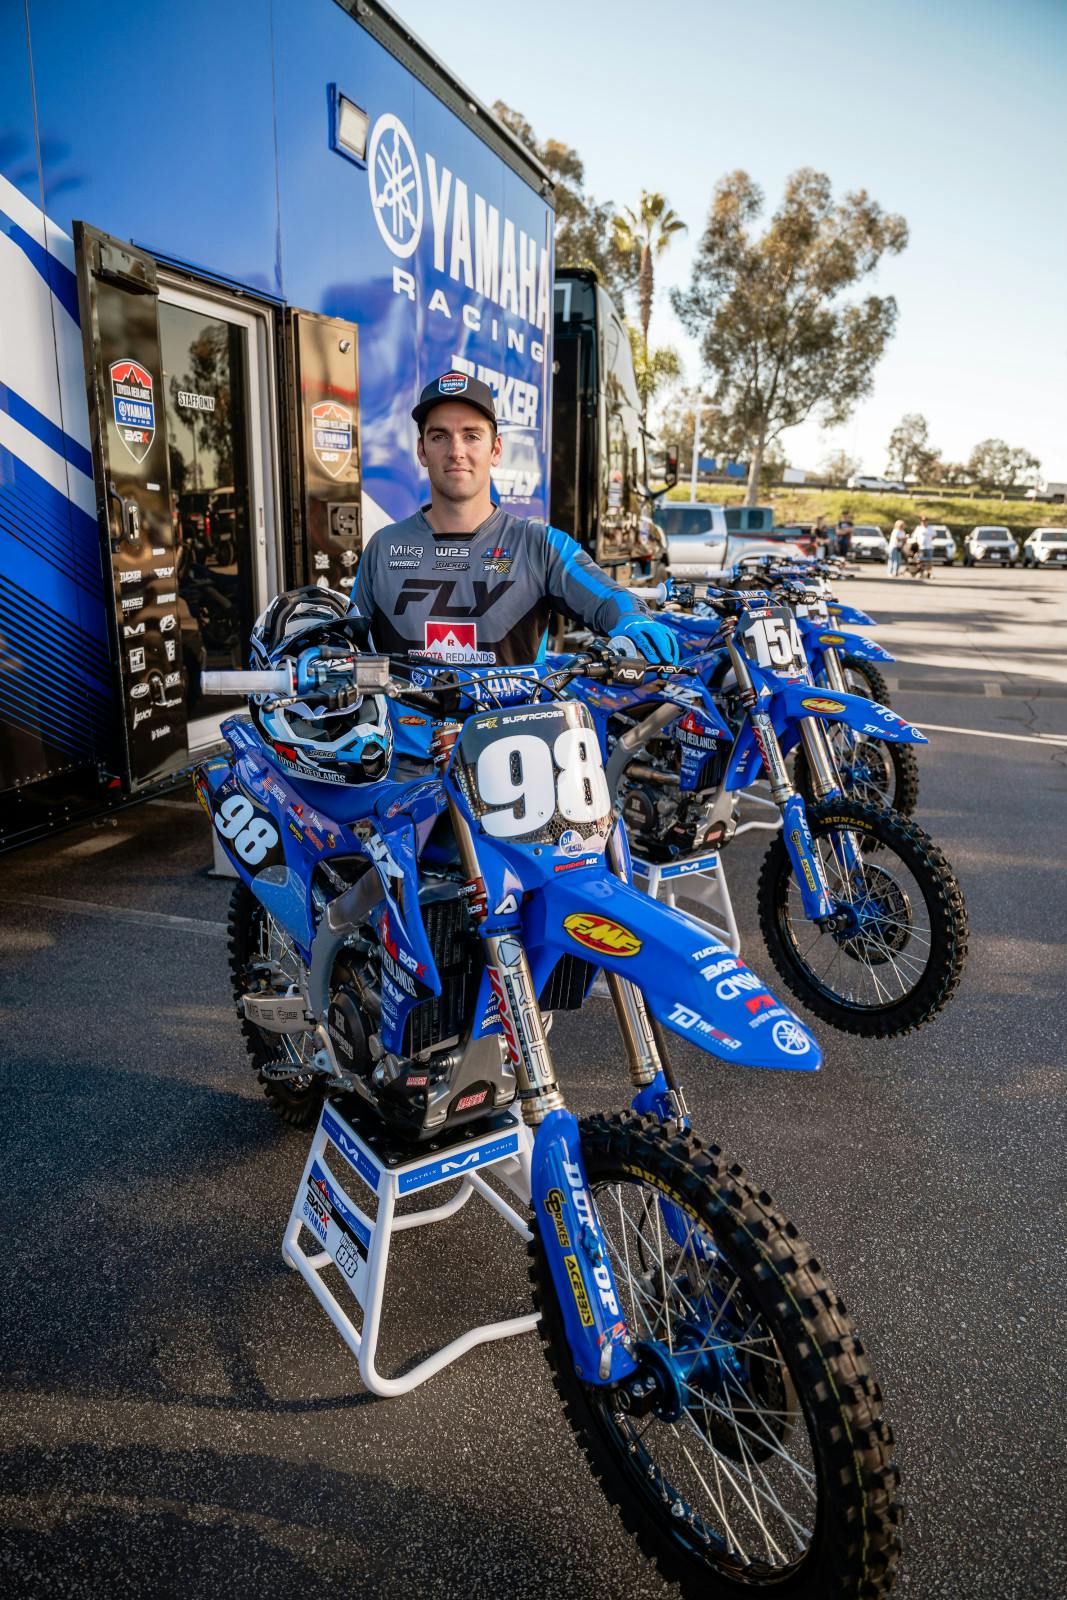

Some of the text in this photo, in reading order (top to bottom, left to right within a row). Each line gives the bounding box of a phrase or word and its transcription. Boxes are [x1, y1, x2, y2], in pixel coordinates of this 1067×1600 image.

[425, 153, 551, 335] YAMAHA
[392, 266, 545, 364] RACING
[126, 403, 151, 420] YAMAHA
[178, 391, 215, 412] STAFF ONLY
[490, 468, 541, 496] FLY
[388, 560, 421, 568] TWISTED
[390, 545, 424, 559] Mika
[435, 547, 470, 557] WPS
[393, 579, 517, 617] FLY
[447, 639, 455, 647] R
[446, 652, 495, 663] REDLANDS
[618, 668, 645, 680] ASV
[657, 666, 683, 674] ASV
[502, 710, 565, 726] SUPERCROSS
[687, 734, 717, 750] REDLANDS
[302, 766, 346, 783] REDLANDS
[476, 728, 612, 838] 98
[214, 794, 279, 866] 98
[563, 914, 643, 950] FMF
[667, 1002, 702, 1029] TD
[406, 1169, 437, 1184] MATRIX
[485, 1142, 513, 1155] MATRIX
[308, 1208, 328, 1243] YAMAHA
[336, 1245, 359, 1279] 98
[564, 1254, 594, 1327] ACERBIS
